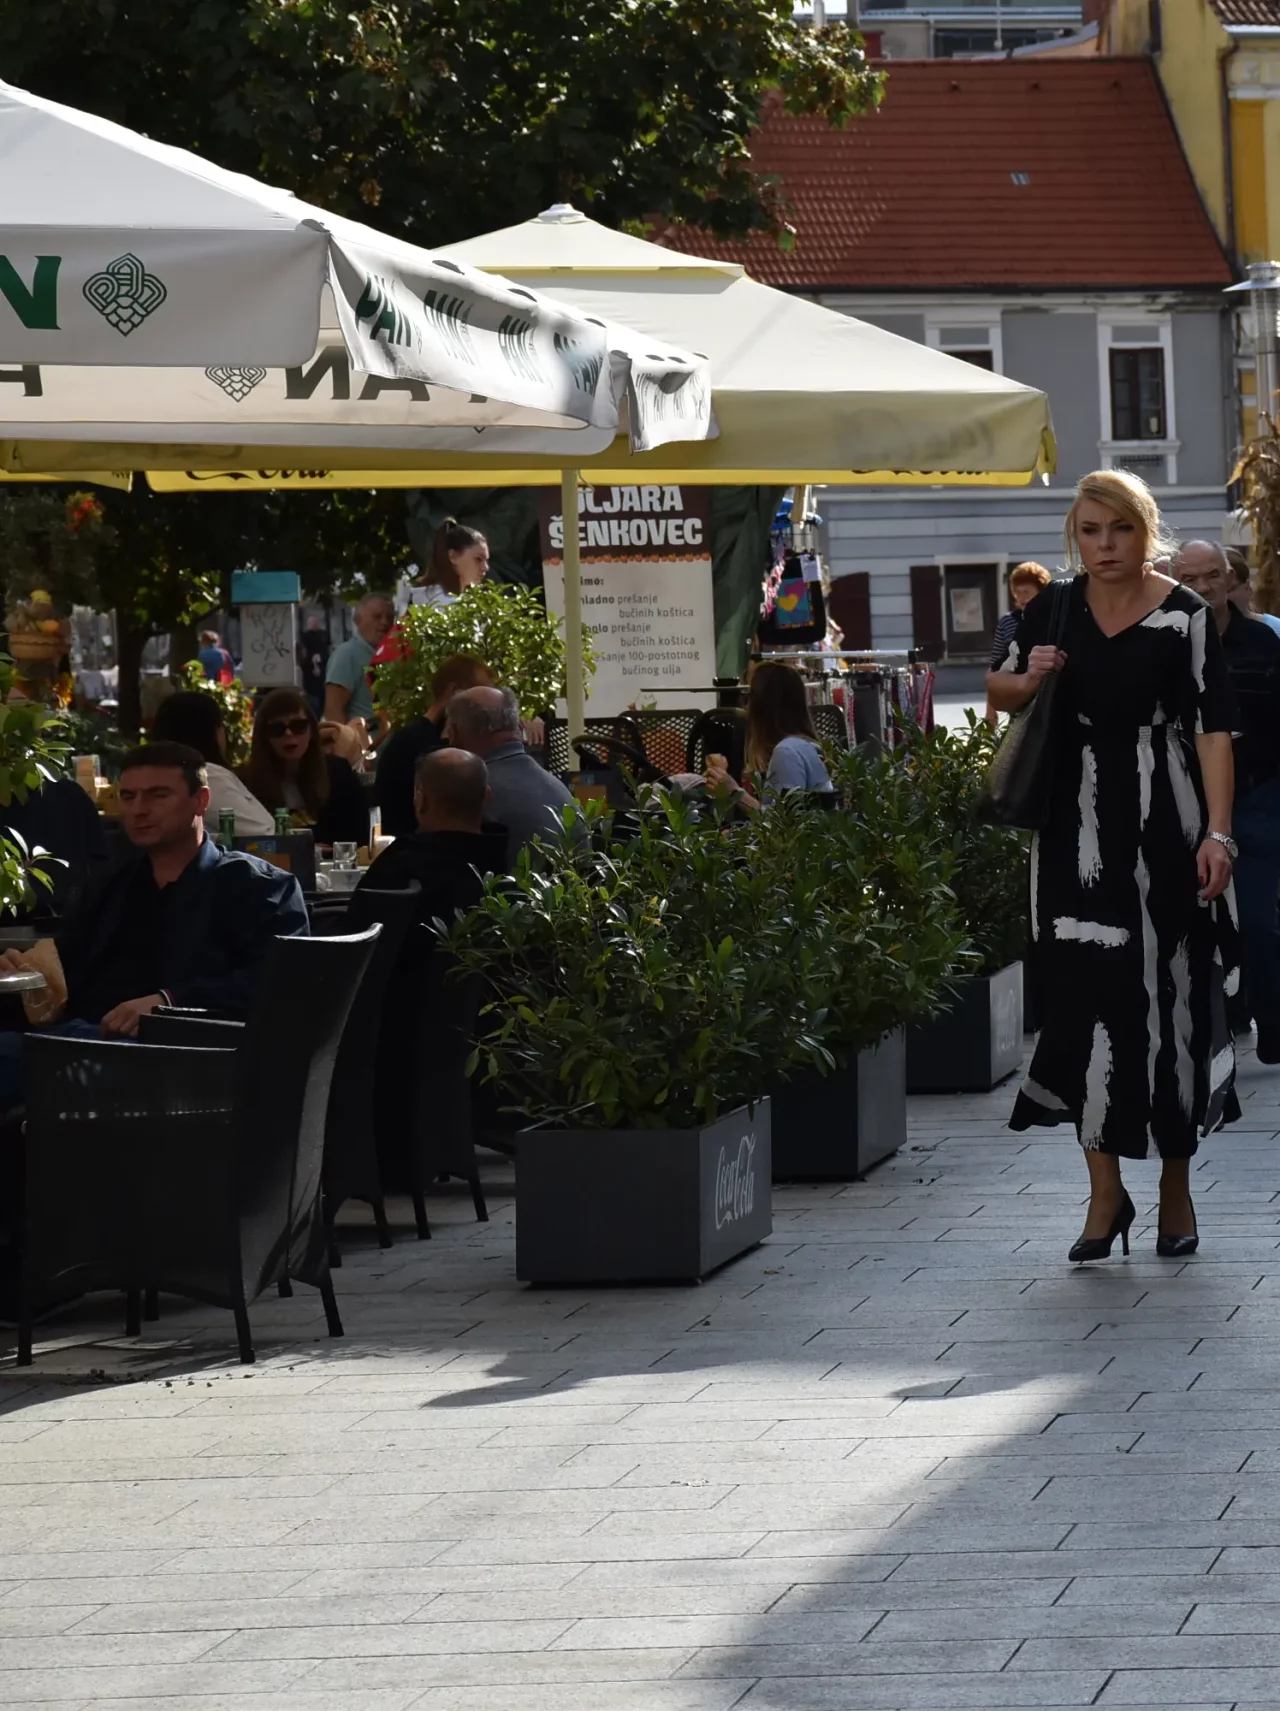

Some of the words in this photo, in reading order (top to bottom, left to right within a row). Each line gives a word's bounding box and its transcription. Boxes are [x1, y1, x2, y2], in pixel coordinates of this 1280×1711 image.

[617, 594, 658, 606] prešanje
[619, 608, 654, 618] bučinih
[657, 607, 694, 617] koštica
[611, 622, 651, 634] prešanje
[620, 636, 655, 647] bučinih
[658, 636, 695, 646] koštica
[629, 651, 700, 662] 100-postotnog
[622, 666, 659, 676] bučinog
[662, 664, 681, 676] ulja
